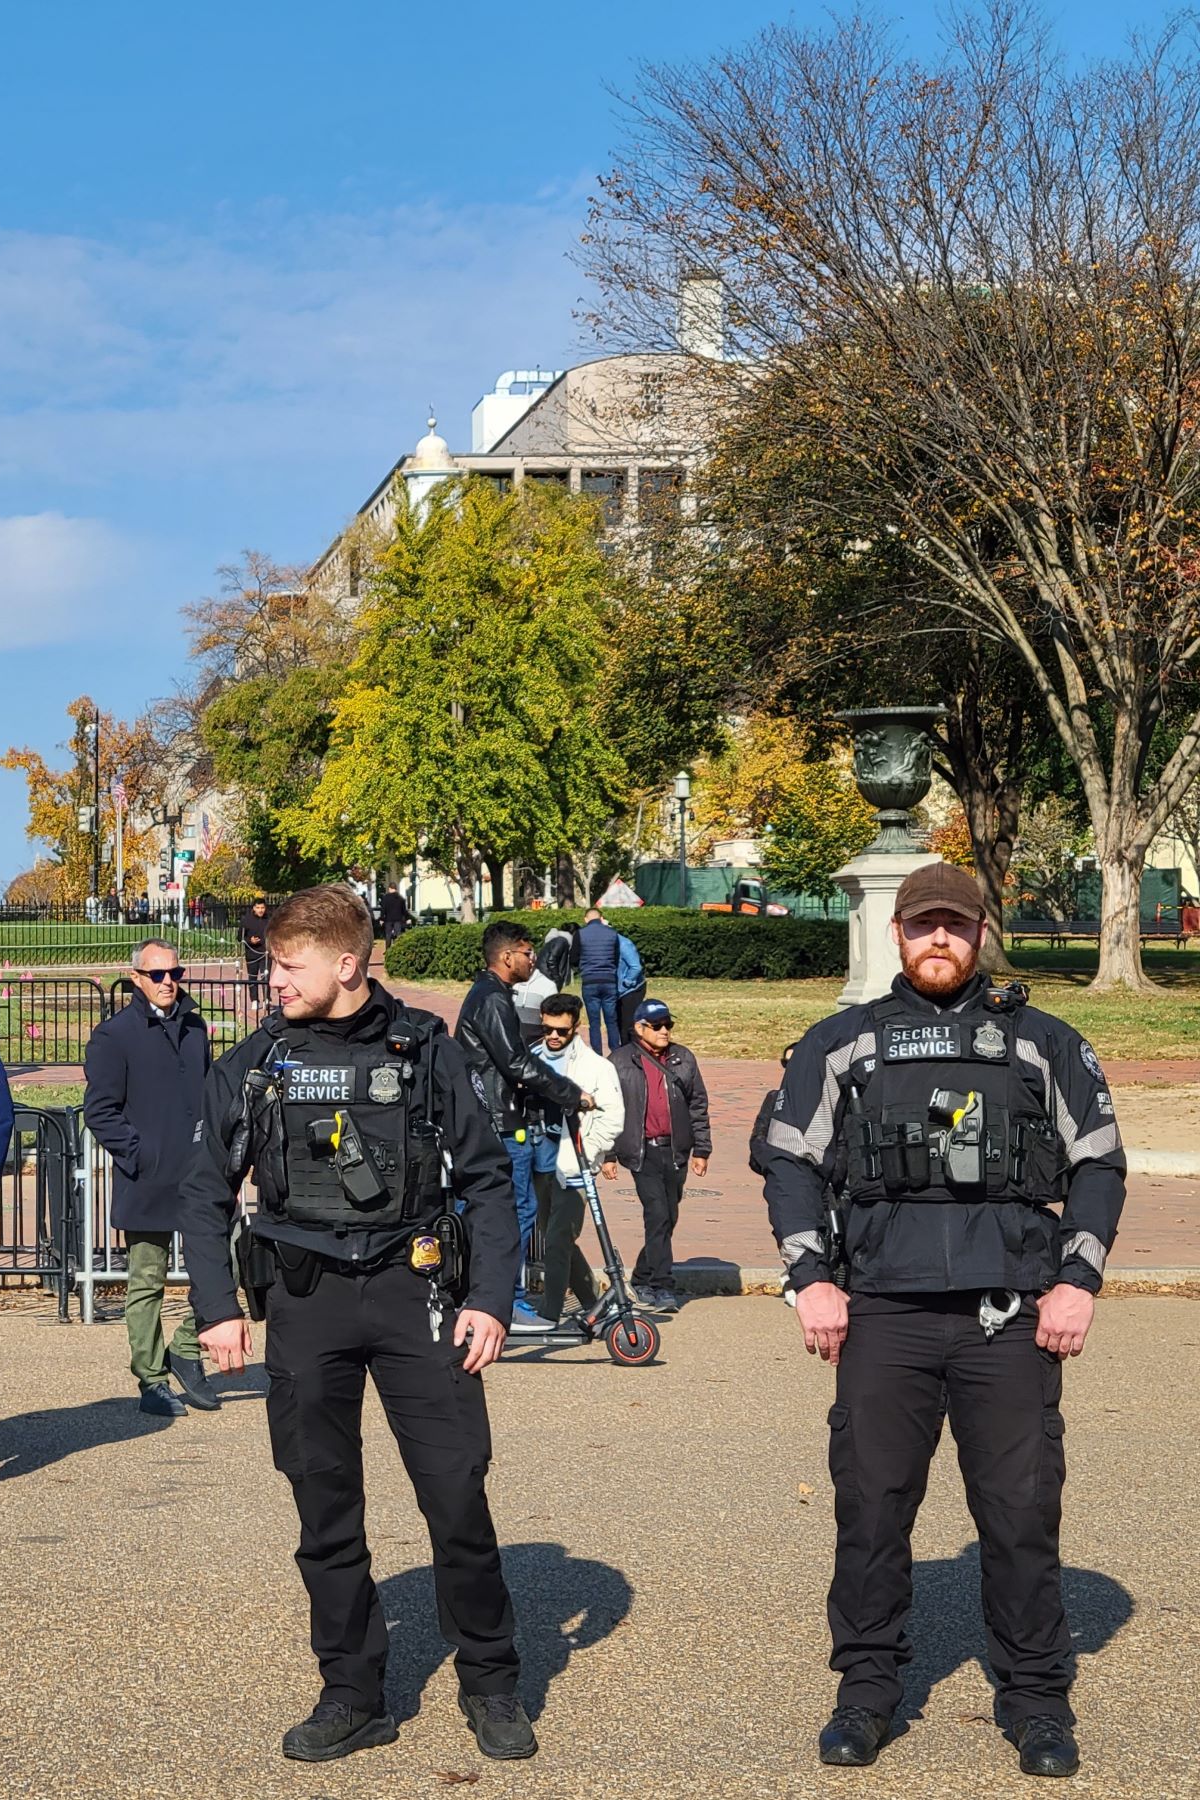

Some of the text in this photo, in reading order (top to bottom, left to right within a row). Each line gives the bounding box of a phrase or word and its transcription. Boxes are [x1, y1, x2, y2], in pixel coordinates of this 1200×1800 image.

[892, 1026, 951, 1042] SECRET
[888, 1041, 955, 1058] SERVICE
[291, 1069, 348, 1083] SECRET
[288, 1086, 350, 1100] SERVICE
